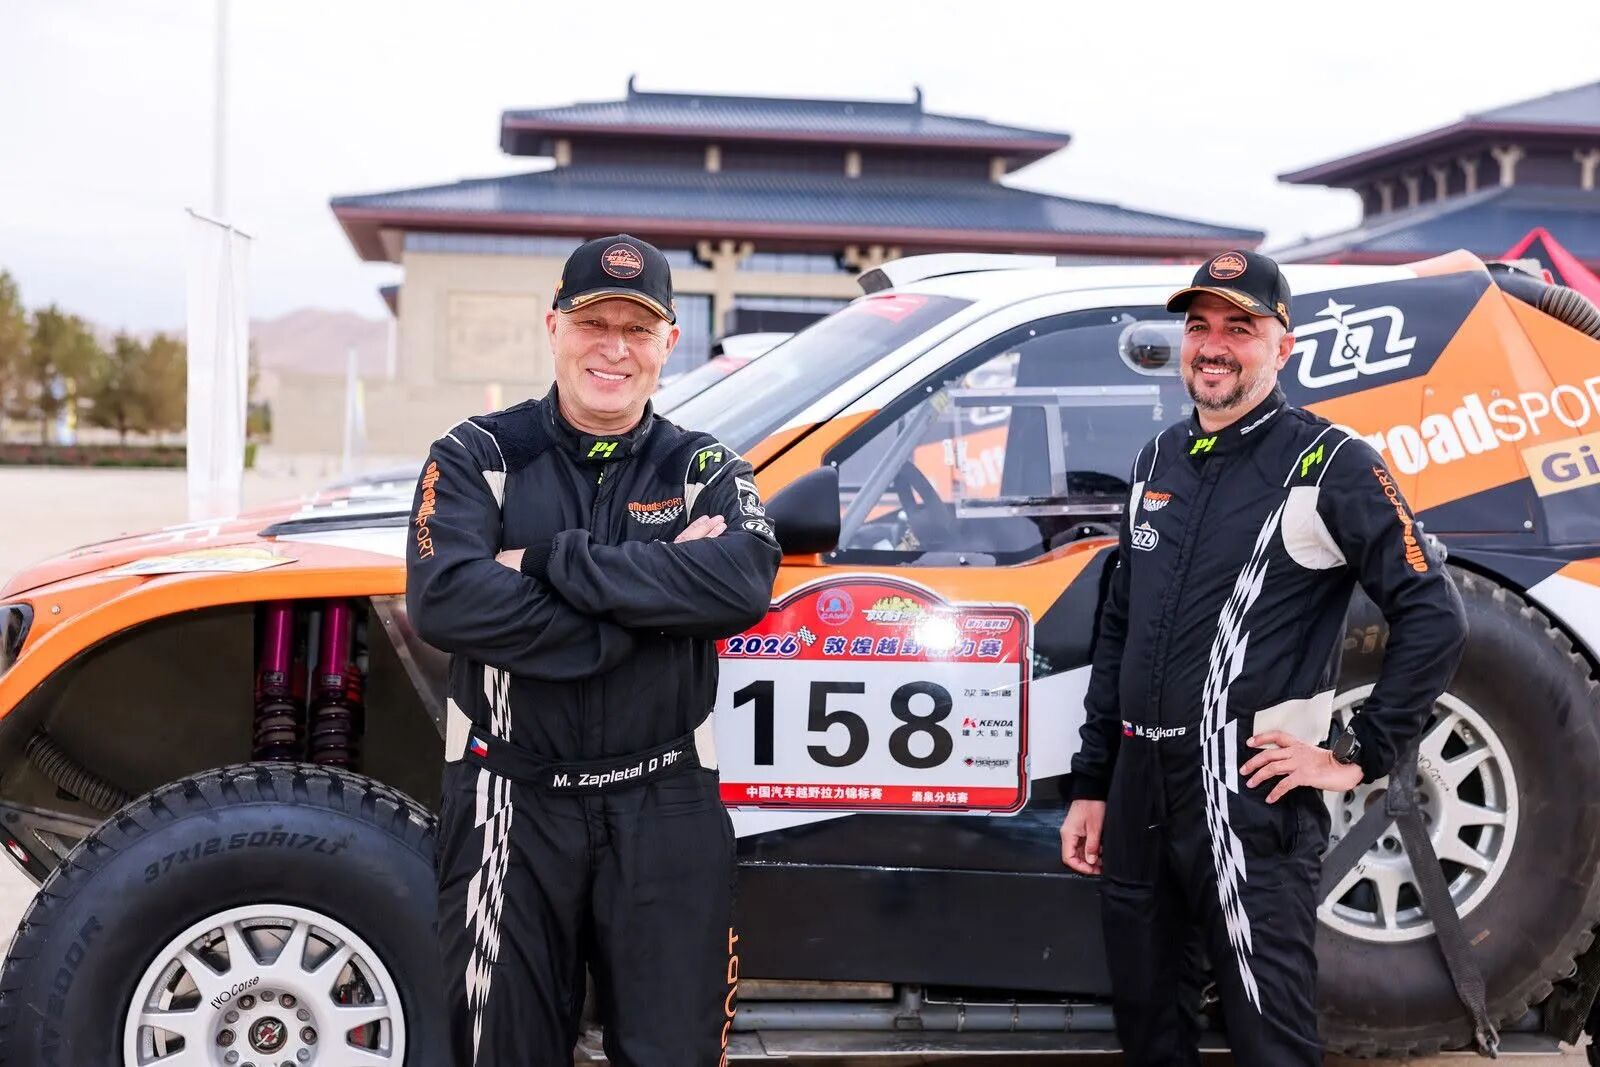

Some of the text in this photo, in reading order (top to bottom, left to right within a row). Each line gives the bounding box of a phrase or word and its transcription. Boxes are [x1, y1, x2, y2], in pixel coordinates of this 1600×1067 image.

[587, 441, 619, 458] P1
[727, 635, 798, 655] 2026
[823, 635, 1004, 657] 敦煌越野力赛
[733, 679, 953, 769] 158
[979, 719, 1014, 727] KENDA
[1135, 725, 1145, 736] M.
[553, 774, 572, 788] M.
[578, 762, 643, 788] Zapletal
[746, 785, 969, 804] 中国汽车越野拉力锦标赛 酒泉分站赛
